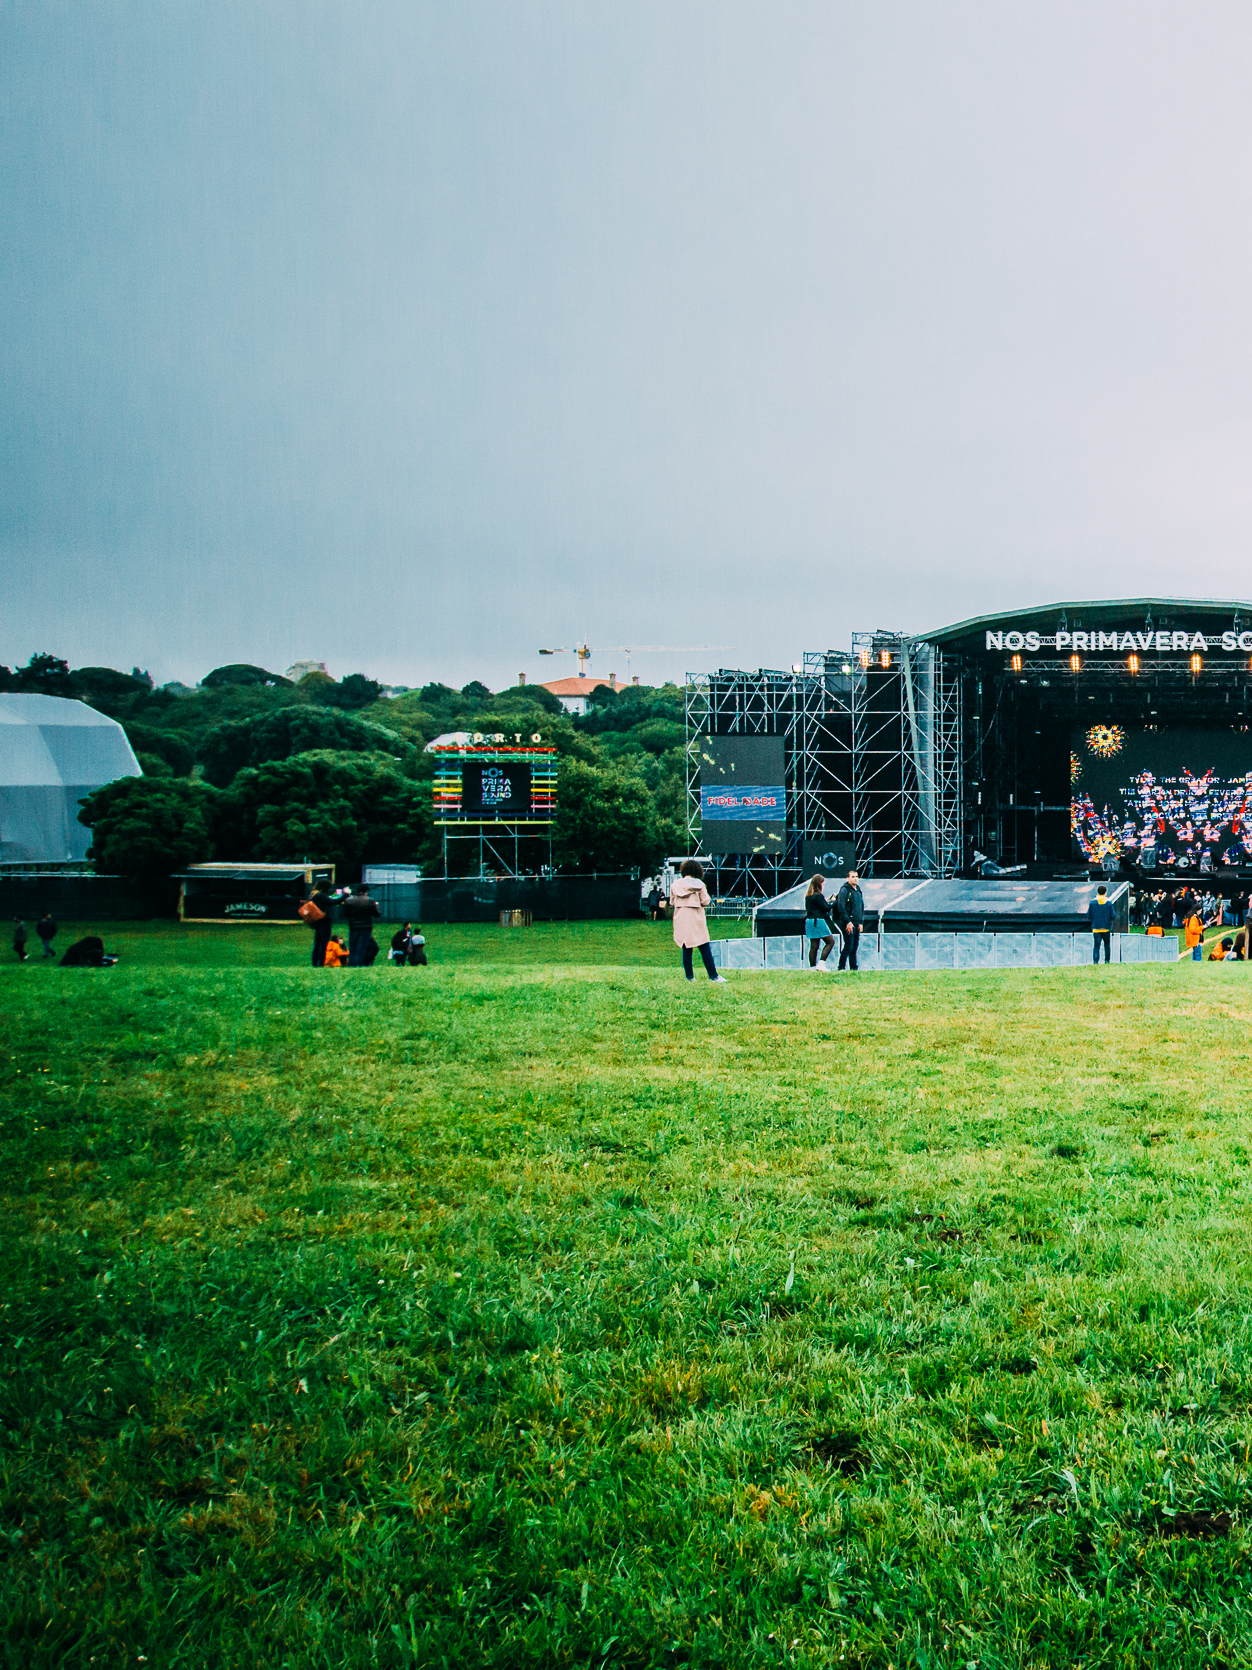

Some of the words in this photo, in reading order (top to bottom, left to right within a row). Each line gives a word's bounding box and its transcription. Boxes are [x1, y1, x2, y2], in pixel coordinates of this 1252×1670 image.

[986, 631, 1041, 651] NOS
[1055, 631, 1208, 651] PRIMAVERA
[481, 767, 504, 778] NOS
[1129, 776, 1157, 784] TYLR
[1160, 776, 1176, 784] THE
[814, 852, 844, 869] NOS
[224, 902, 267, 913] JAMESON
